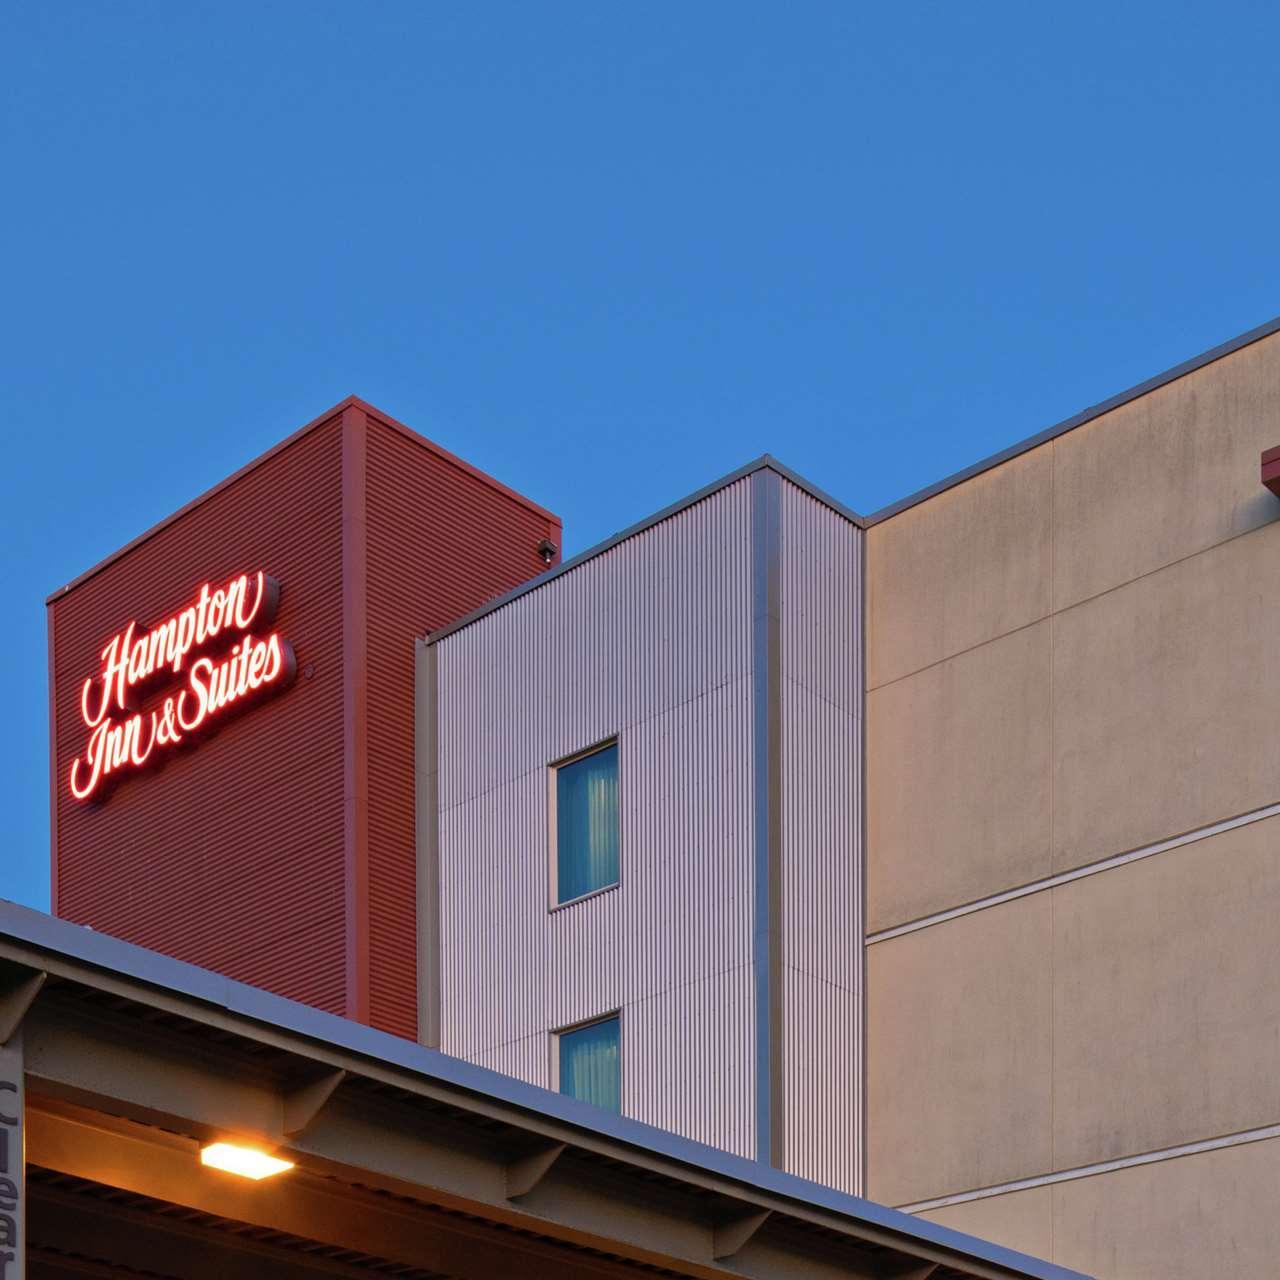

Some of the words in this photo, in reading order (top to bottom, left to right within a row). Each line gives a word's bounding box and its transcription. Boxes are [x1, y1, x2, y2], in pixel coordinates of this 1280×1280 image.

[71, 711, 157, 799] Inn
[157, 697, 182, 745] &
[177, 633, 283, 731] Suites
[82, 570, 264, 728] Hampton
